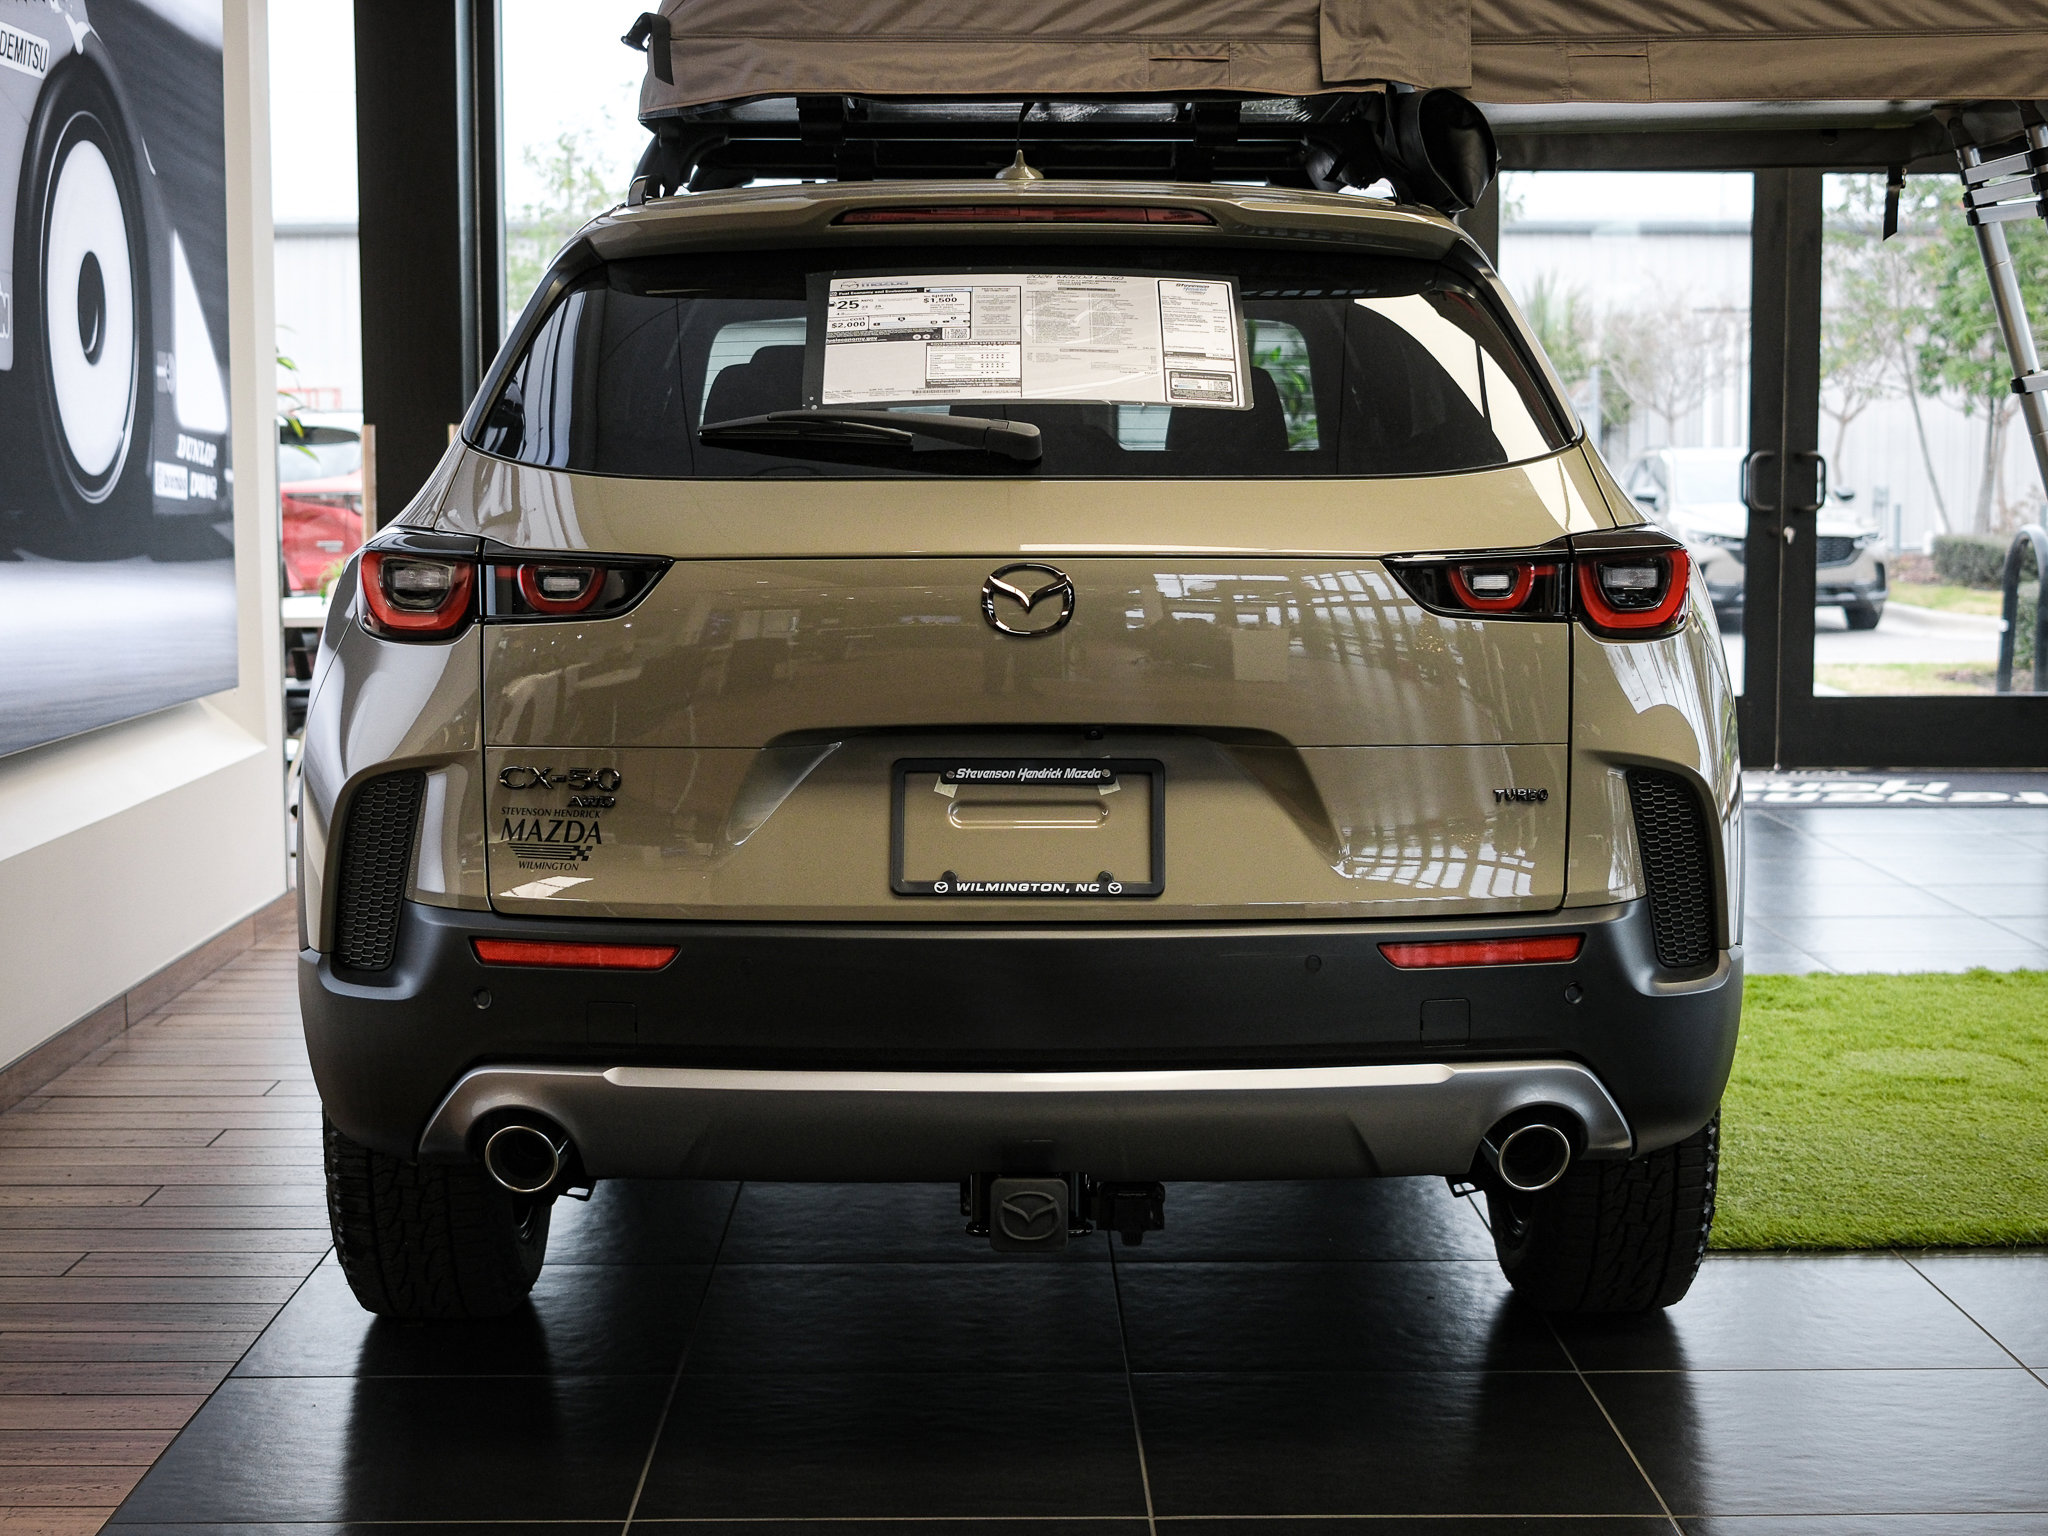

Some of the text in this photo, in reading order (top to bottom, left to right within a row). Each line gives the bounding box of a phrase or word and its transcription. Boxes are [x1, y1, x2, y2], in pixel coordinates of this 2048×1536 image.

[837, 299, 860, 310] 25
[831, 321, 866, 329] $2,000
[177, 433, 217, 468] DUNLOP
[499, 766, 621, 792] CX-50
[955, 767, 1101, 781] Stevenson Hendrick Mazda
[568, 795, 616, 808] AWD
[1493, 788, 1549, 802] TURBO
[501, 807, 601, 818] STEVENSON HENDRICK
[500, 818, 602, 844] MAZDA
[518, 860, 579, 871] WILMINGTON
[956, 883, 1100, 894] WILMINGTON, NC
